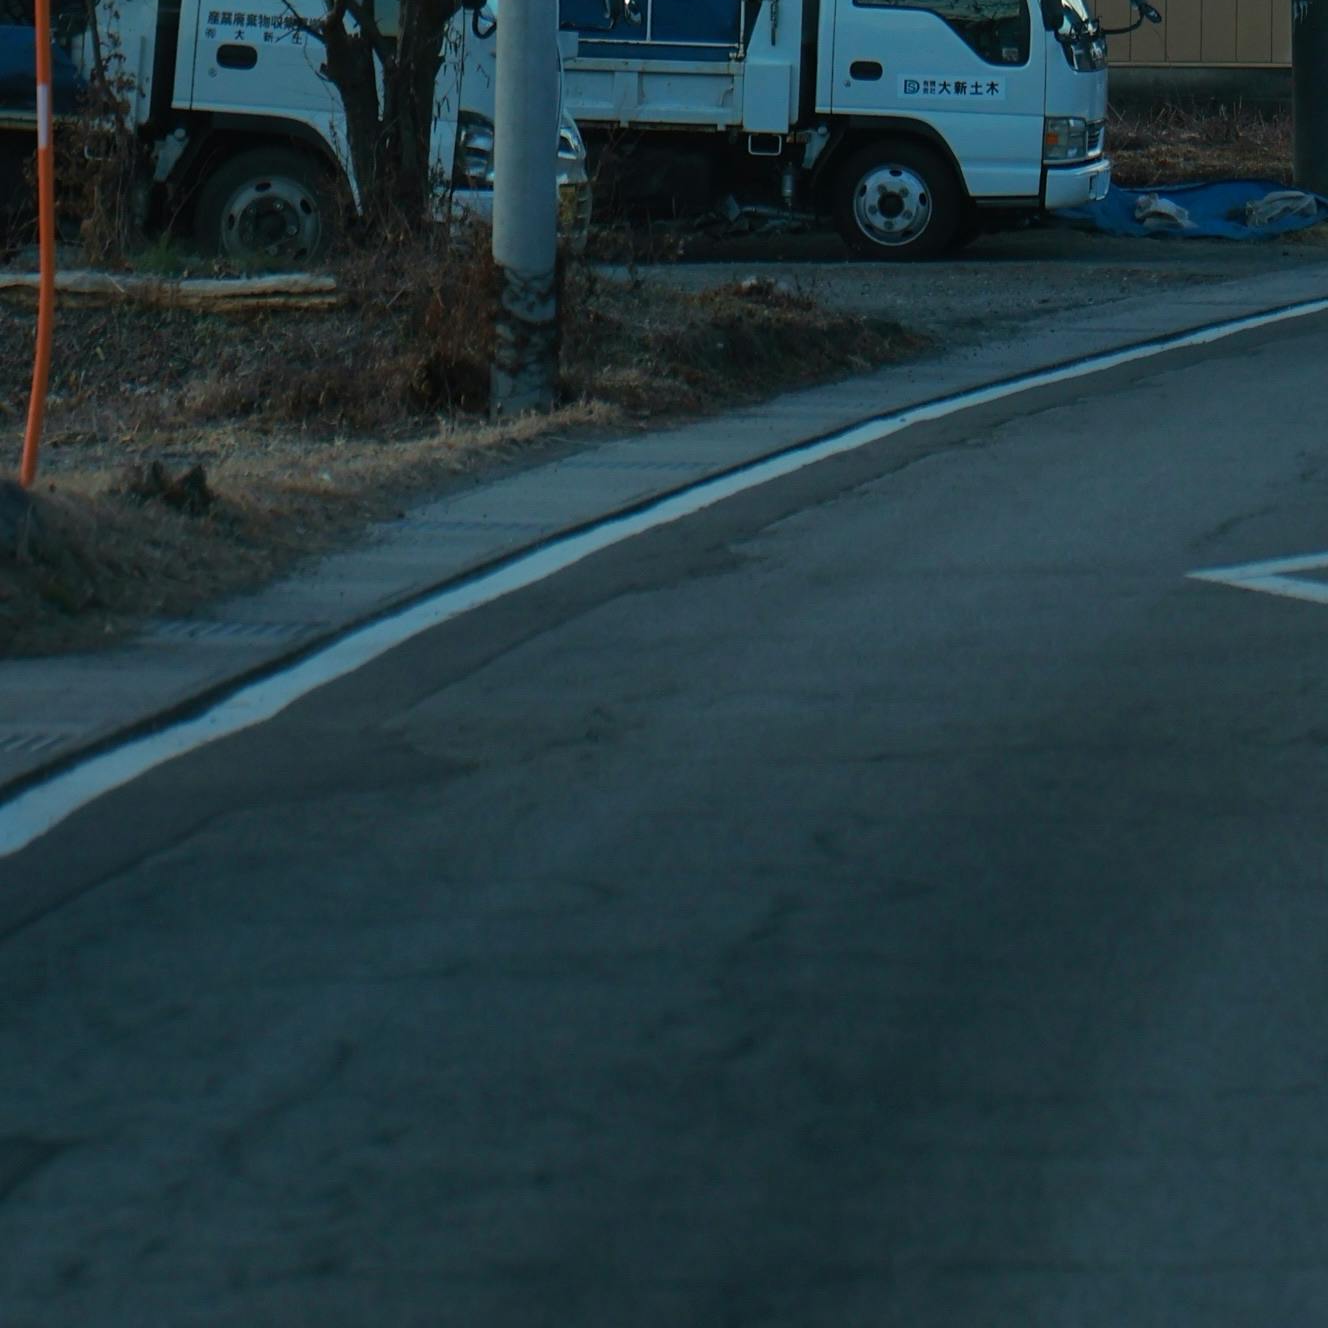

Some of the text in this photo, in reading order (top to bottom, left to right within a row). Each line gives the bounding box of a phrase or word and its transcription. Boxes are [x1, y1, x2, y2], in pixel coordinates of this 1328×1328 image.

[207, 11, 323, 31] 産業廃棄物収集
[938, 79, 999, 96] 大新土木
